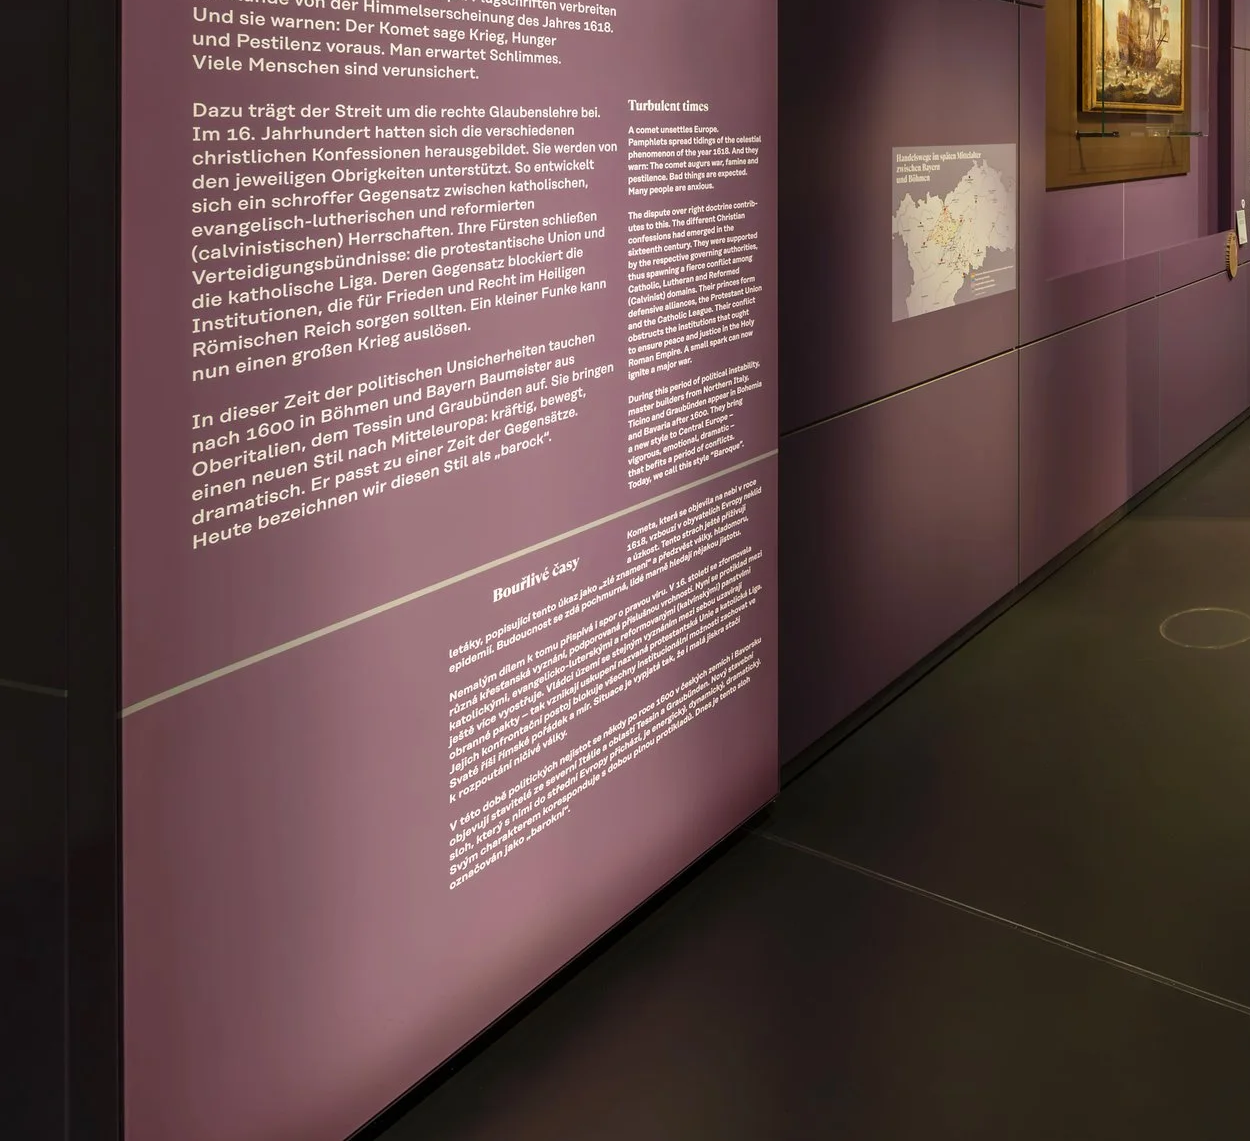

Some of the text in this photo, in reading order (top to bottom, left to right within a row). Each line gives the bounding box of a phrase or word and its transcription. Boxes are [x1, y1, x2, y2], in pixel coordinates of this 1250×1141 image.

[364, 0, 515, 28] Himmelserscheinung
[517, 14, 539, 27] des
[542, 16, 581, 30] Jahres
[584, 20, 614, 33] 1618.
[559, 2, 616, 16] verbreiten
[193, 7, 557, 48] Und sie warnen: Der Komet sage Krieg, Hunger
[193, 32, 561, 64] und Pestilenz voraus. Man erwartet Schlimmes.
[192, 54, 479, 79] Viele Menschen sind verunsichert.
[193, 102, 600, 121] Dazu trägt der Streit um die rechte Glaubenslehre bei.
[628, 99, 709, 112] Turbulent times
[193, 124, 574, 141] Im 16. Jahrhundert hatten sich die verschiedenen
[628, 125, 719, 134] A comet unsettles Europe.
[628, 135, 762, 148] Pamphlets spread tidings of the celestial
[192, 142, 618, 165] christlichen Konfessionen herausgebildet. Sie werden von
[628, 150, 675, 160] phenomenon
[676, 148, 684, 157] of
[684, 148, 697, 156] the
[697, 149, 712, 158] year
[713, 147, 731, 155] 1618.
[745, 146, 759, 155] they
[650, 161, 664, 170] The
[664, 160, 687, 169] comet
[688, 160, 711, 169] augurs
[725, 158, 746, 166] famine
[192, 159, 595, 191] den jeweiligen Obrigkeiten unterstützt. So entwickelt
[628, 174, 668, 185] pestilence.
[669, 172, 683, 181] Bad
[684, 171, 705, 181] things
[717, 168, 748, 178] expected.
[896, 175, 908, 184] und
[192, 177, 588, 213] sich ein schroffer Gegensatz zwischen katholischen,
[192, 199, 535, 237] evangelisch-lutherischen und reformierten
[192, 211, 597, 263] (calvinistischen) Herrschaften. Ihre Fürsten schließen
[192, 226, 605, 285] Verteidigungsbündnisse: die protestantische Union und
[192, 247, 583, 309] die katholische Liga. Deren Gegensatz blockiert die
[192, 266, 585, 334] Institutionen, die für Frieden und Recht im Heiligen
[627, 522, 658, 539] Kometa,
[659, 511, 678, 526] která
[679, 509, 687, 517] se
[688, 497, 714, 513] objevila
[715, 493, 723, 502] na
[724, 485, 738, 498] nebi
[743, 479, 757, 490] roce
[493, 557, 580, 603] Bouřlivé časy
